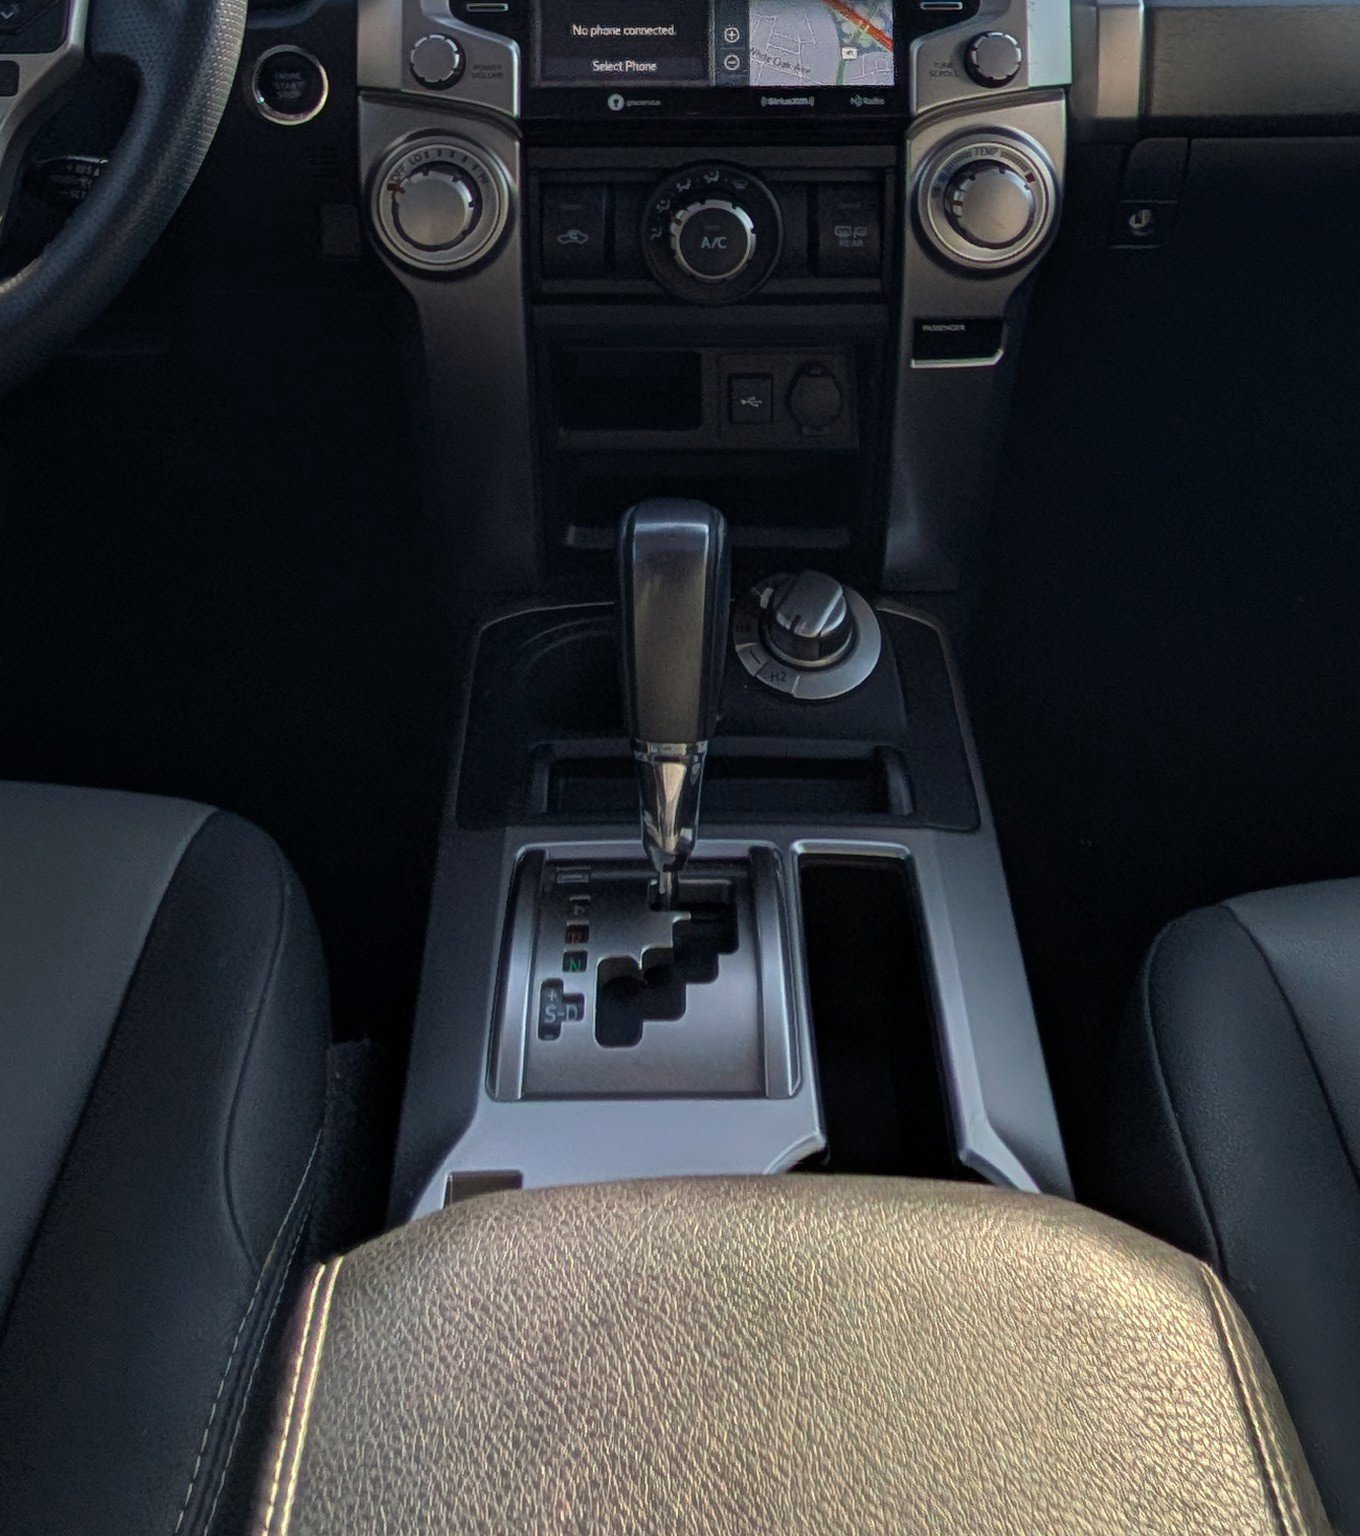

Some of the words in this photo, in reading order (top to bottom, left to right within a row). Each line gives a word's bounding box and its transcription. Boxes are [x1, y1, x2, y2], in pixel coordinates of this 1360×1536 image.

[571, 24, 589, 37] No
[590, 23, 622, 39] phone
[592, 60, 623, 72] Select
[625, 60, 658, 72] Phone
[700, 235, 728, 250] A/C
[568, 957, 582, 973] N
